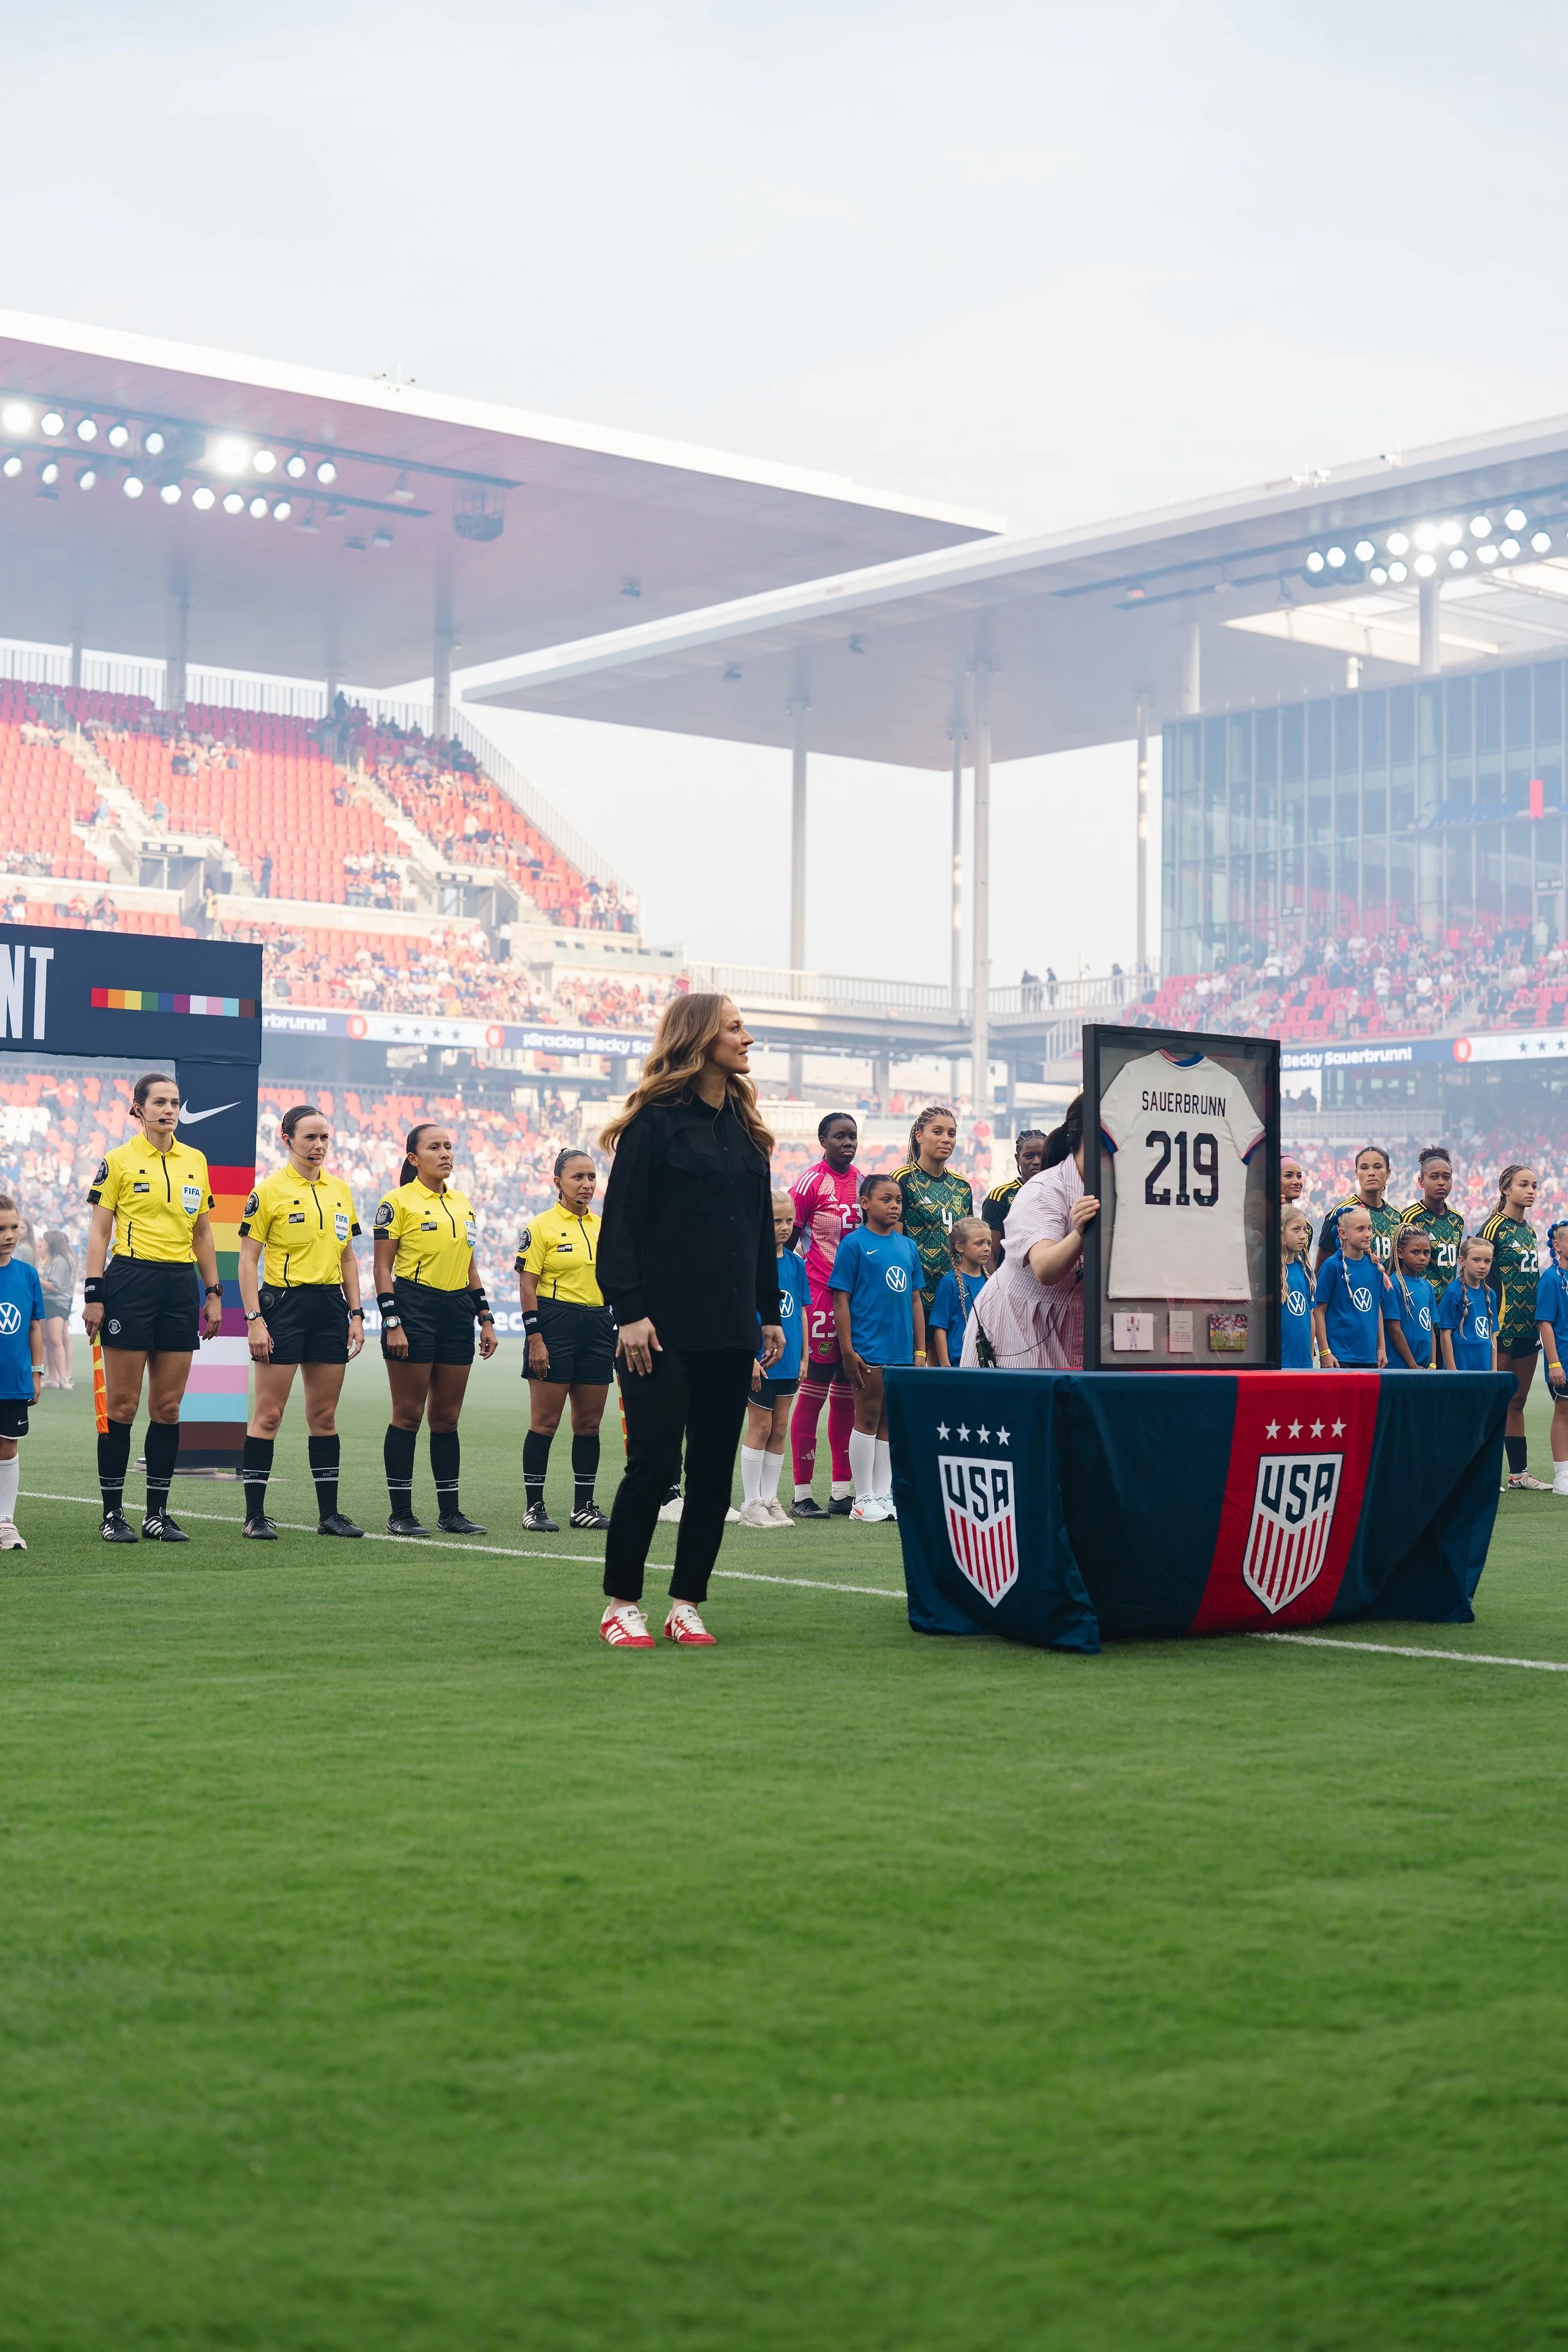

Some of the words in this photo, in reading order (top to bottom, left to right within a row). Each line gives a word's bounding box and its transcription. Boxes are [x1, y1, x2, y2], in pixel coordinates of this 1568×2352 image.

[0, 944, 54, 1040] NT
[586, 1037, 631, 1054] Becky
[1283, 1053, 1322, 1068] Becky
[1324, 1047, 1412, 1065] Sauerbrunn!
[1142, 1091, 1226, 1117] SAUERBRUNN
[1145, 1130, 1219, 1207] 219
[184, 1187, 200, 1196] FIFA
[336, 1214, 347, 1224] FIFA
[839, 1204, 864, 1228] 23
[941, 1208, 952, 1233] 4
[1375, 1236, 1391, 1259] 18
[1438, 1243, 1456, 1266] 20
[1521, 1250, 1538, 1272] 22
[886, 1266, 906, 1292] VW
[1288, 1291, 1305, 1315] VW
[1353, 1288, 1372, 1311] VW
[944, 1465, 1009, 1523] USA
[1261, 1463, 1336, 1524] USA
